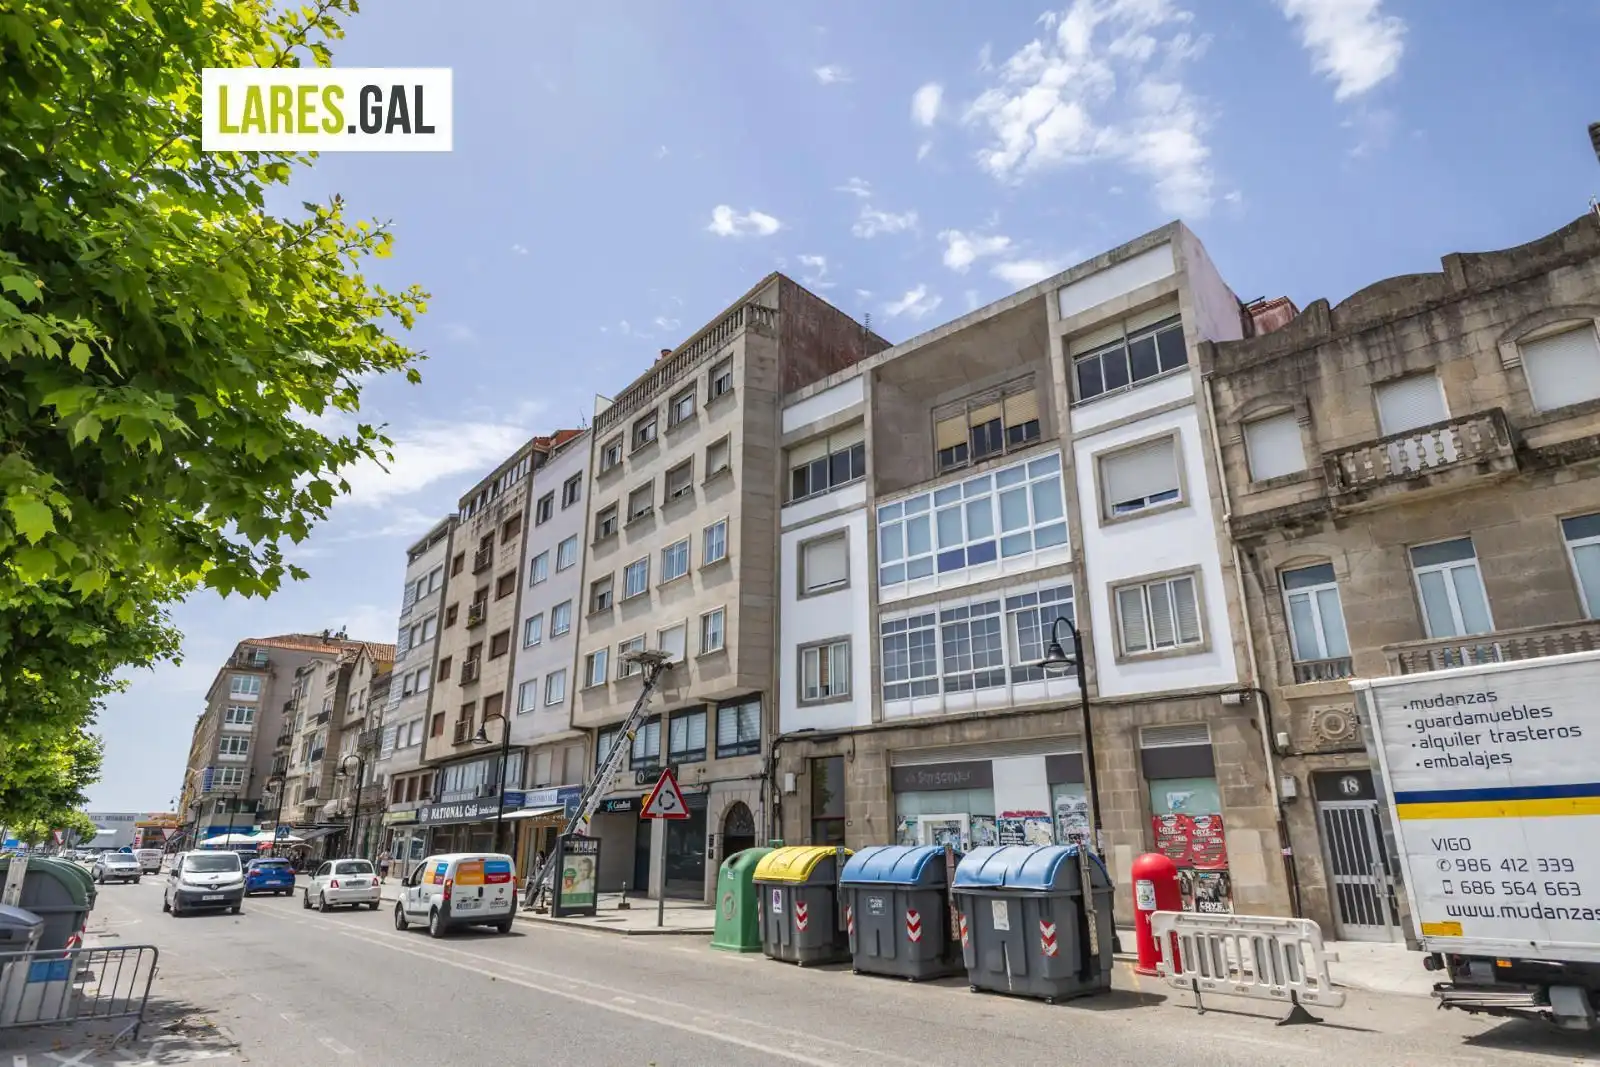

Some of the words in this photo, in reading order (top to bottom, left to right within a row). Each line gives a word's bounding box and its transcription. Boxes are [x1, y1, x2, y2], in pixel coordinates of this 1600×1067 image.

[1409, 690, 1498, 710] mudanzas
[1414, 705, 1554, 733] guardamuebles
[1418, 733, 1482, 752] alquiler
[1489, 724, 1582, 744] trasteros
[1423, 751, 1513, 770] embalajes
[1341, 779, 1359, 793] 18
[431, 805, 463, 820] NATIONAL
[464, 803, 478, 817] Café
[1431, 837, 1472, 851] VIGO
[1455, 858, 1492, 872] 986
[1500, 858, 1529, 873] 412
[1537, 858, 1575, 873] 339
[1460, 880, 1495, 896] 686
[1501, 881, 1537, 896] 564
[1544, 881, 1581, 897] 663
